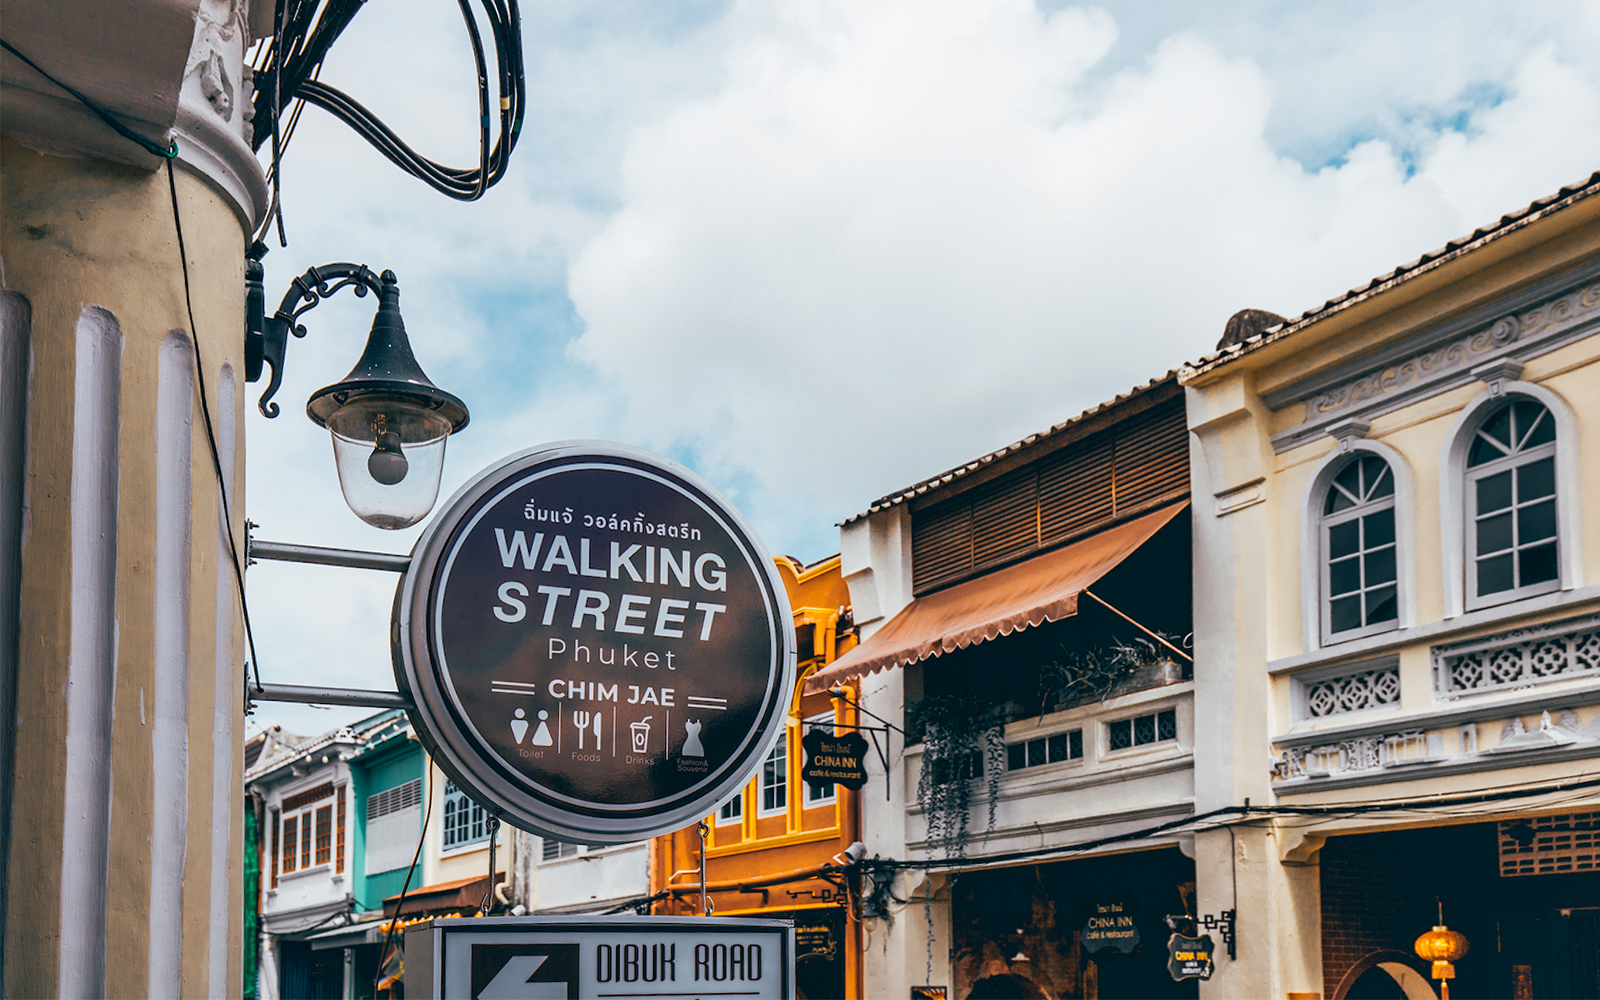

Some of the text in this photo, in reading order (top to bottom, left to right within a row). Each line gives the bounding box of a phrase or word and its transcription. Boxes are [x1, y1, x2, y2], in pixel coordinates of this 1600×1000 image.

[494, 527, 727, 592] WALKING
[493, 581, 726, 641] STREET
[548, 638, 676, 670] Phuket
[548, 679, 675, 707] CHIM JAE
[518, 748, 544, 759] Toilet
[571, 751, 601, 763] Foods
[625, 755, 655, 766] Drinks
[814, 755, 857, 768] CHINA INN
[677, 764, 708, 773] Souvenir
[830, 771, 861, 779] restaurant
[1088, 916, 1133, 929] CHINA INN
[596, 943, 762, 983] DIBUK ROAD
